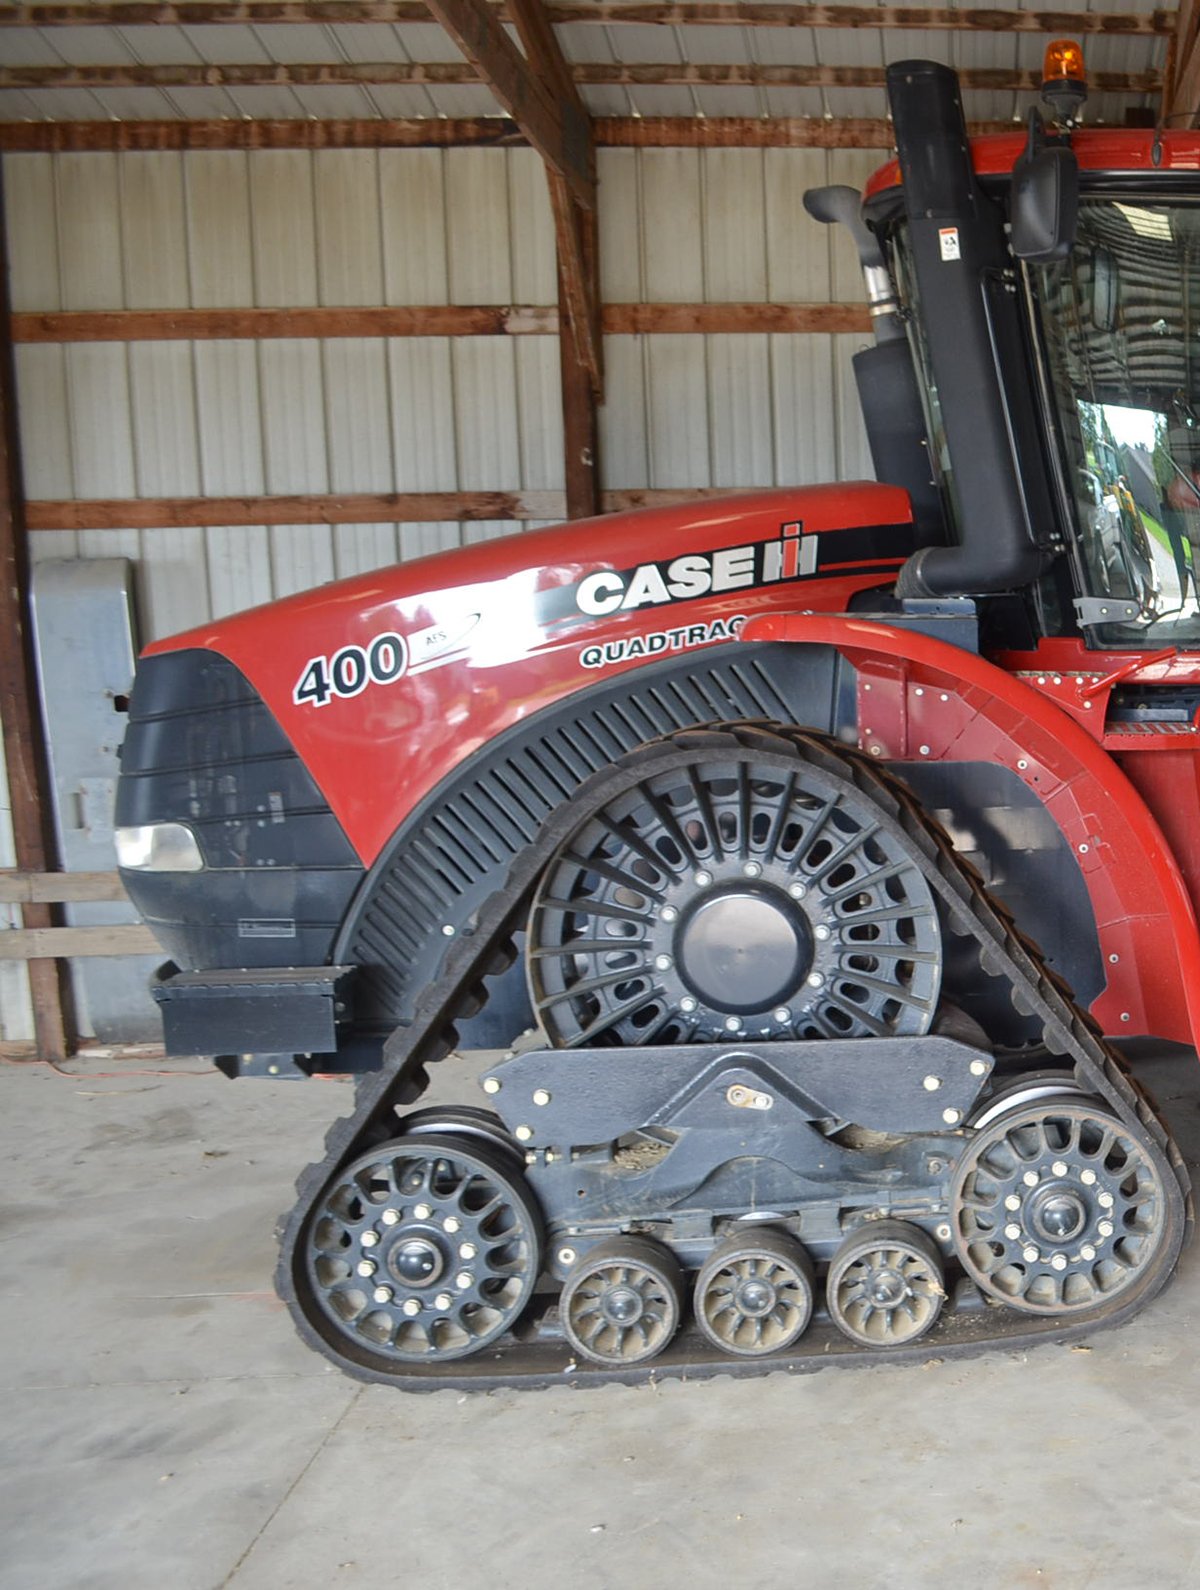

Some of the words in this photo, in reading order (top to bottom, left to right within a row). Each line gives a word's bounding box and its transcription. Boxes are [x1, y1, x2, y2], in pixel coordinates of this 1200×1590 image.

[576, 546, 755, 616] CASE
[293, 632, 408, 708] 400
[425, 631, 448, 646] AFS
